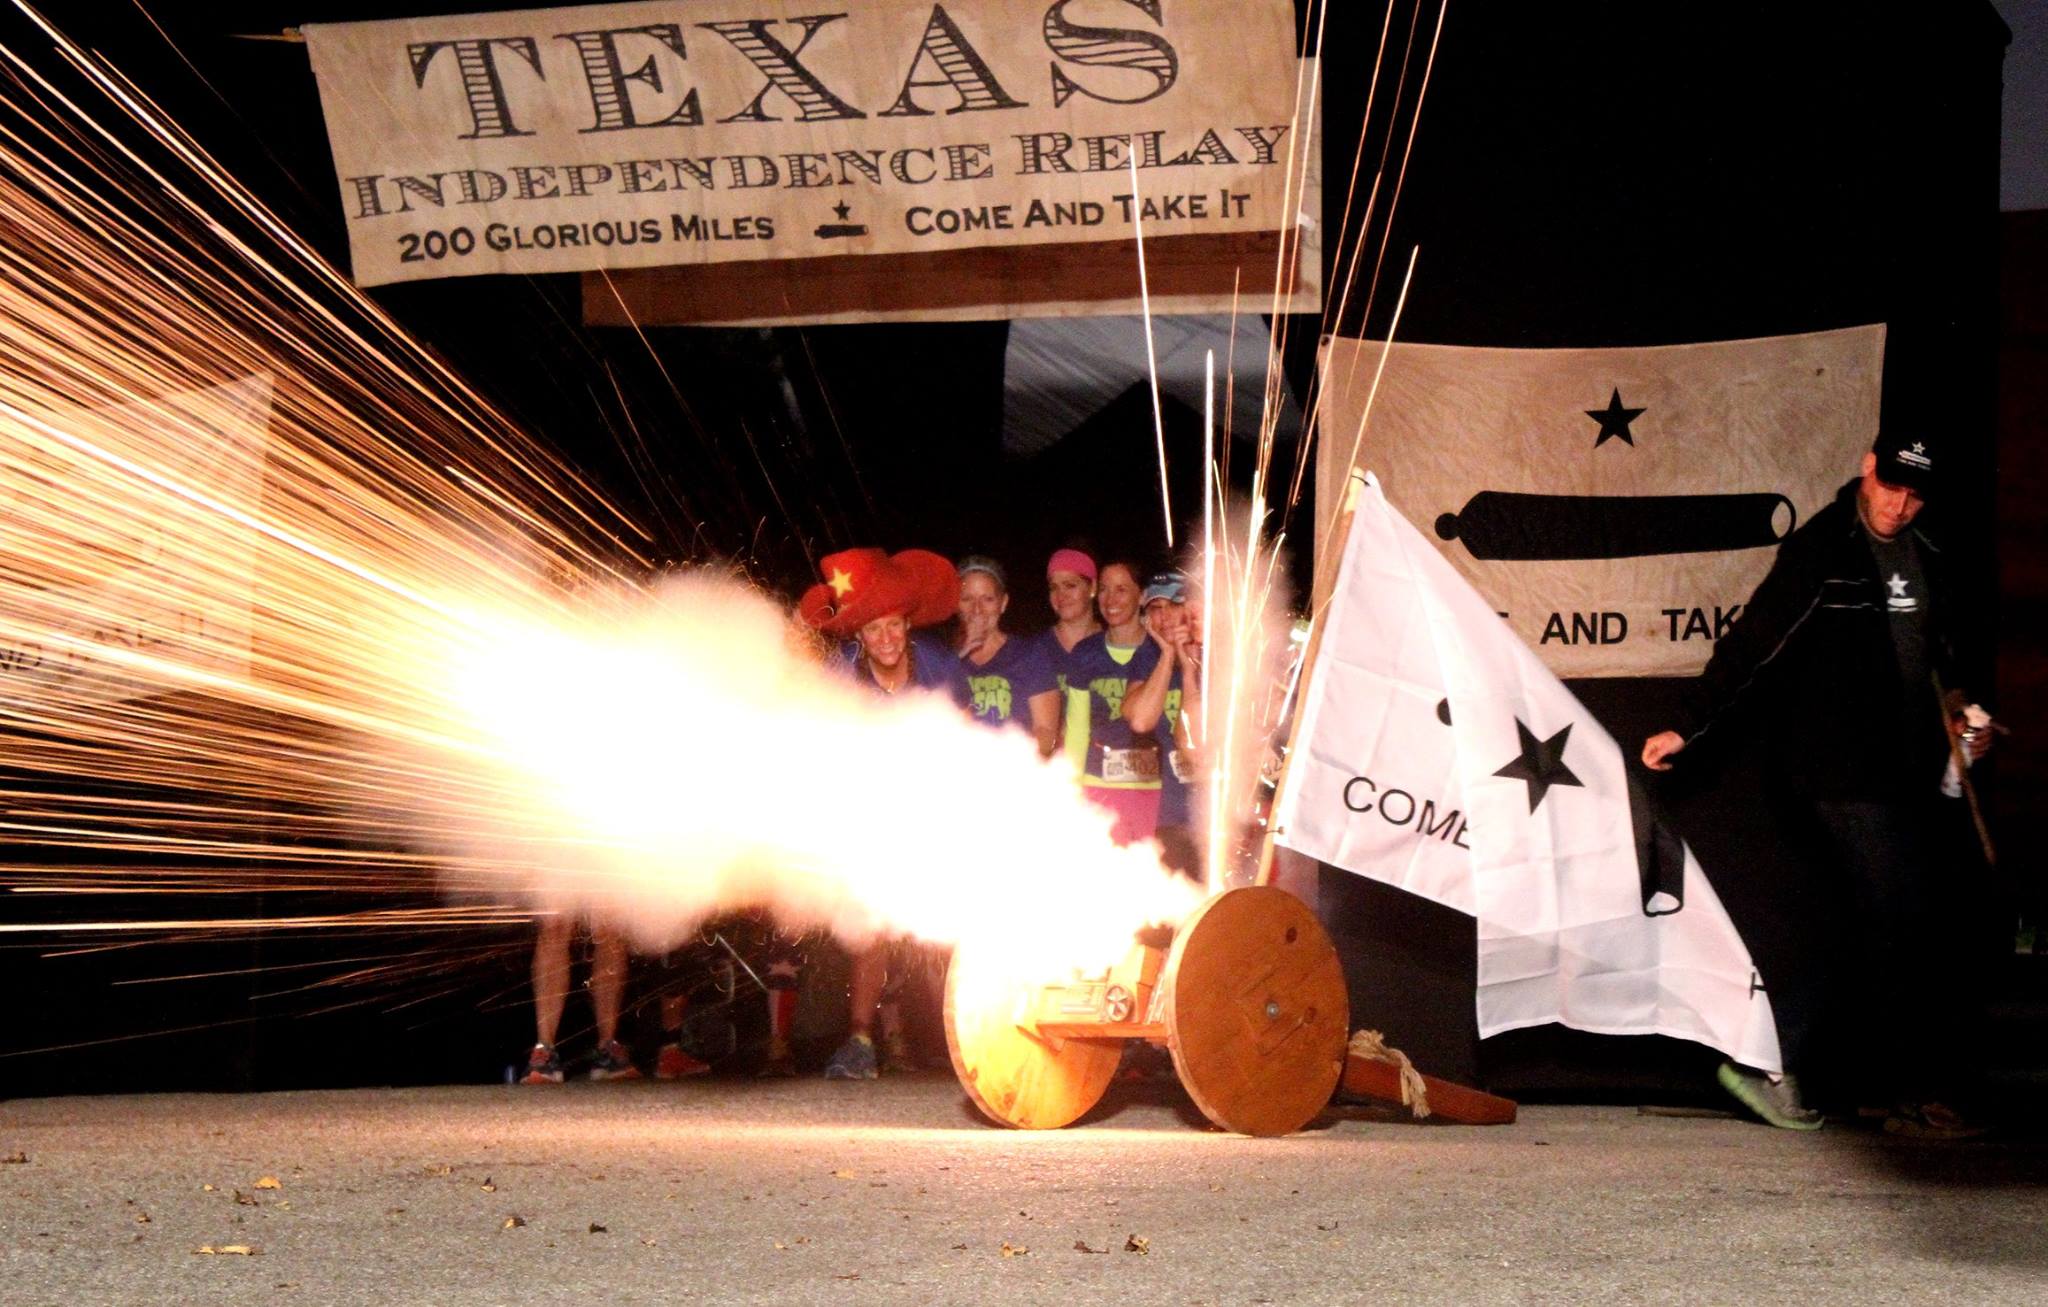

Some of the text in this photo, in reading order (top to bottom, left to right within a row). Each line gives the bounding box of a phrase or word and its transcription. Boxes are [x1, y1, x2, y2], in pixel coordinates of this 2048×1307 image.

[407, 0, 1178, 140] TEXAS
[346, 125, 1290, 219] INDEPENDENCE RELAY
[905, 188, 1251, 236] COME AND TAKE IT
[400, 213, 775, 262] 200 GLORIOUS MILES
[1539, 605, 1750, 645] AND TAK
